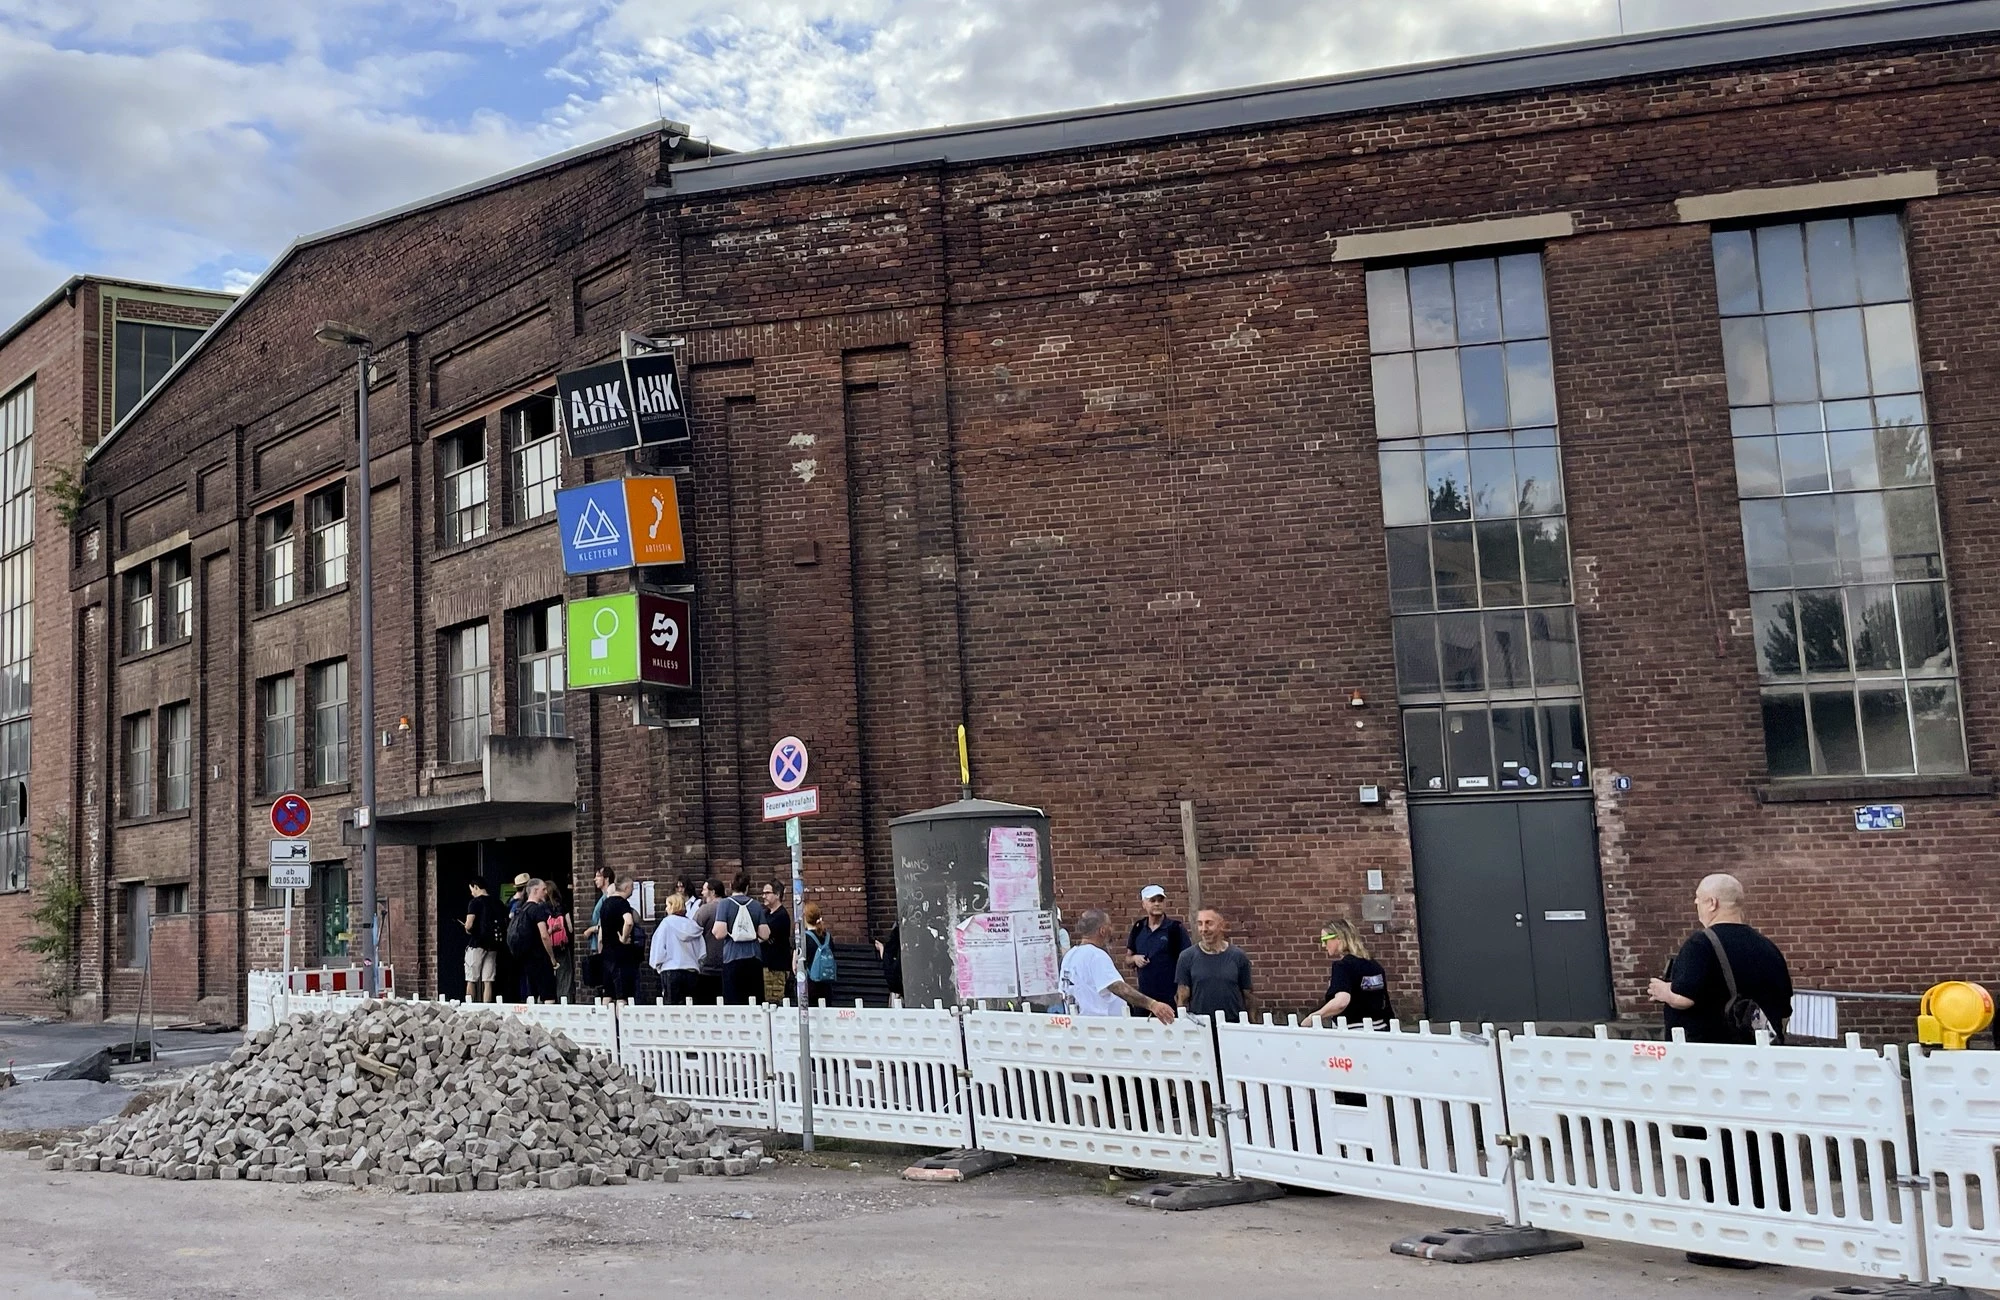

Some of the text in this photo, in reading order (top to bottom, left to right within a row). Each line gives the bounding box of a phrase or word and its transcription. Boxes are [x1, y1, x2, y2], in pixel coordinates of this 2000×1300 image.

[637, 373, 679, 415] AHK
[571, 380, 628, 429] AHK
[578, 547, 618, 561] KLETTERN
[645, 543, 672, 553] ARTISTIK
[652, 658, 679, 670] HALLE59
[588, 666, 611, 677] TRIAL
[765, 795, 815, 811] Feuerwehrzufahrt
[275, 876, 305, 885] 03.05.2024
[1050, 1016, 1072, 1028] step
[1634, 1043, 1667, 1060] step
[1328, 1056, 1353, 1072] step
